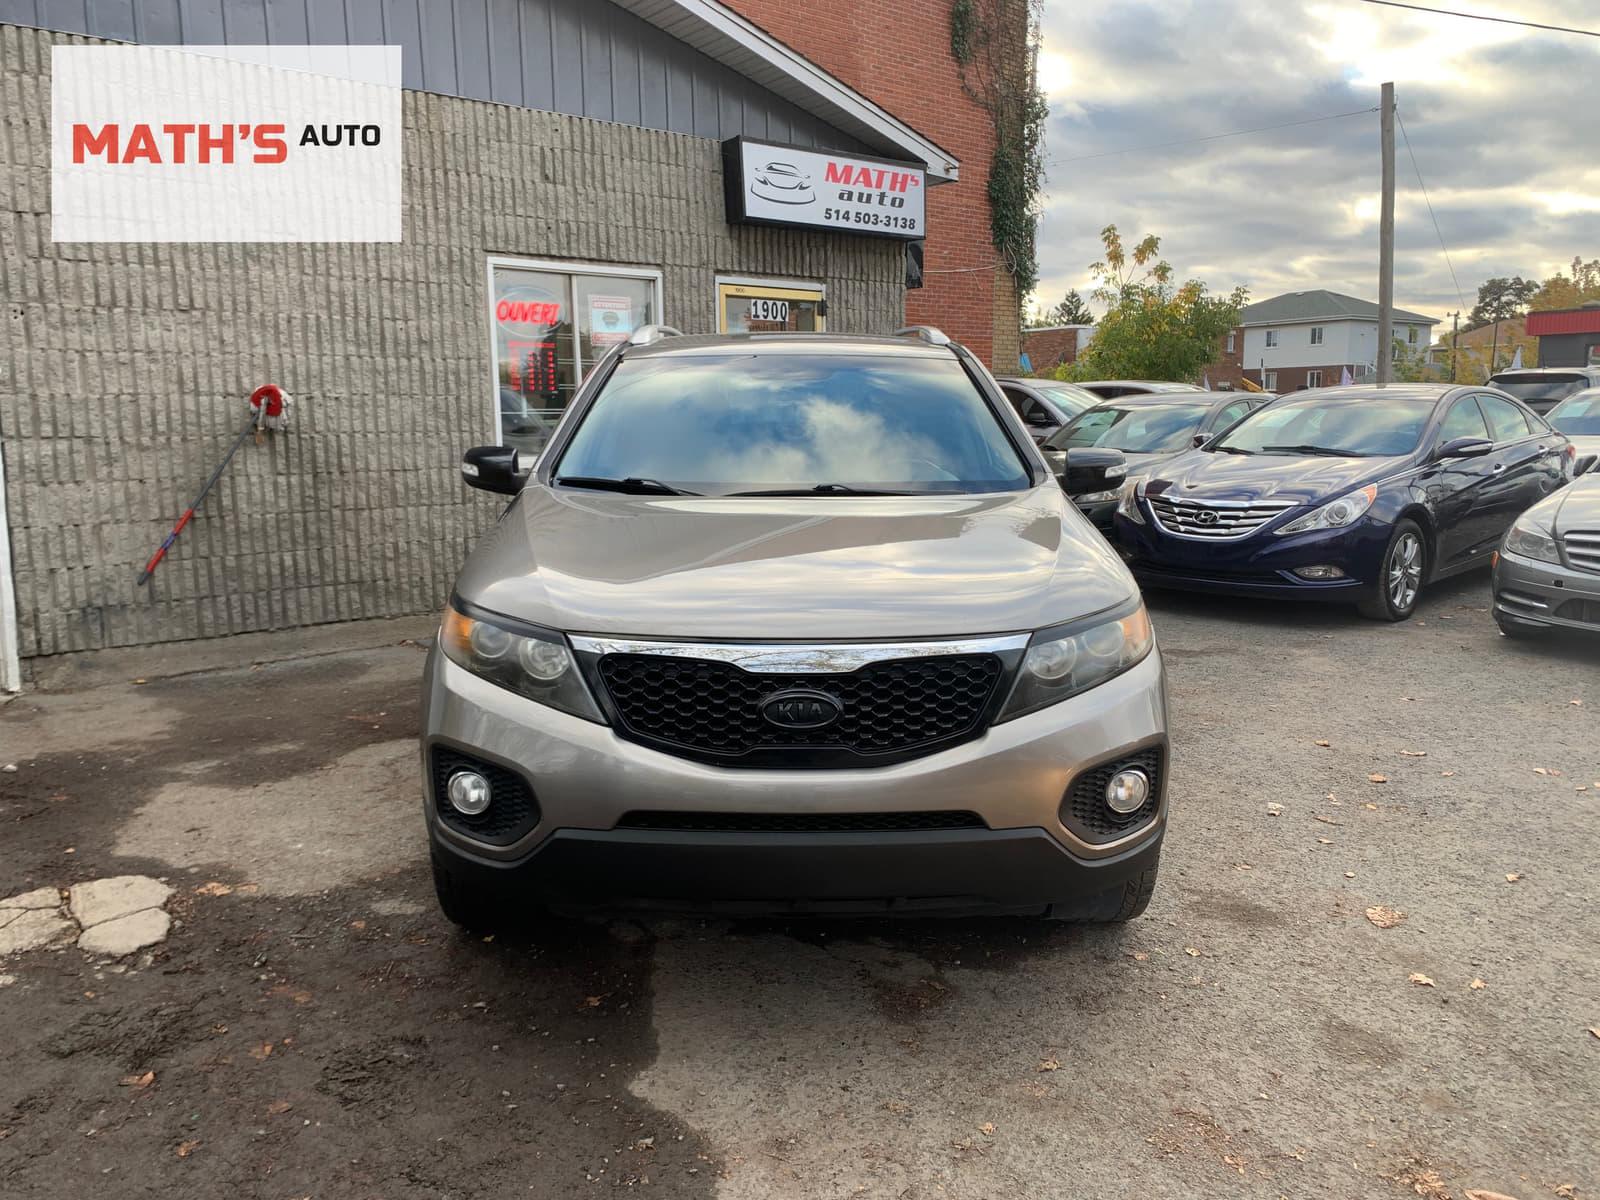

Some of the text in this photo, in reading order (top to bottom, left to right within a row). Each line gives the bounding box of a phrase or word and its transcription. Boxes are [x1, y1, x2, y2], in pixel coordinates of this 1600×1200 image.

[838, 189, 905, 209] auto
[824, 208, 916, 230] 514 503-3138
[496, 299, 561, 325] OUVERT
[752, 300, 788, 321] 1900
[775, 702, 824, 721] KIA
